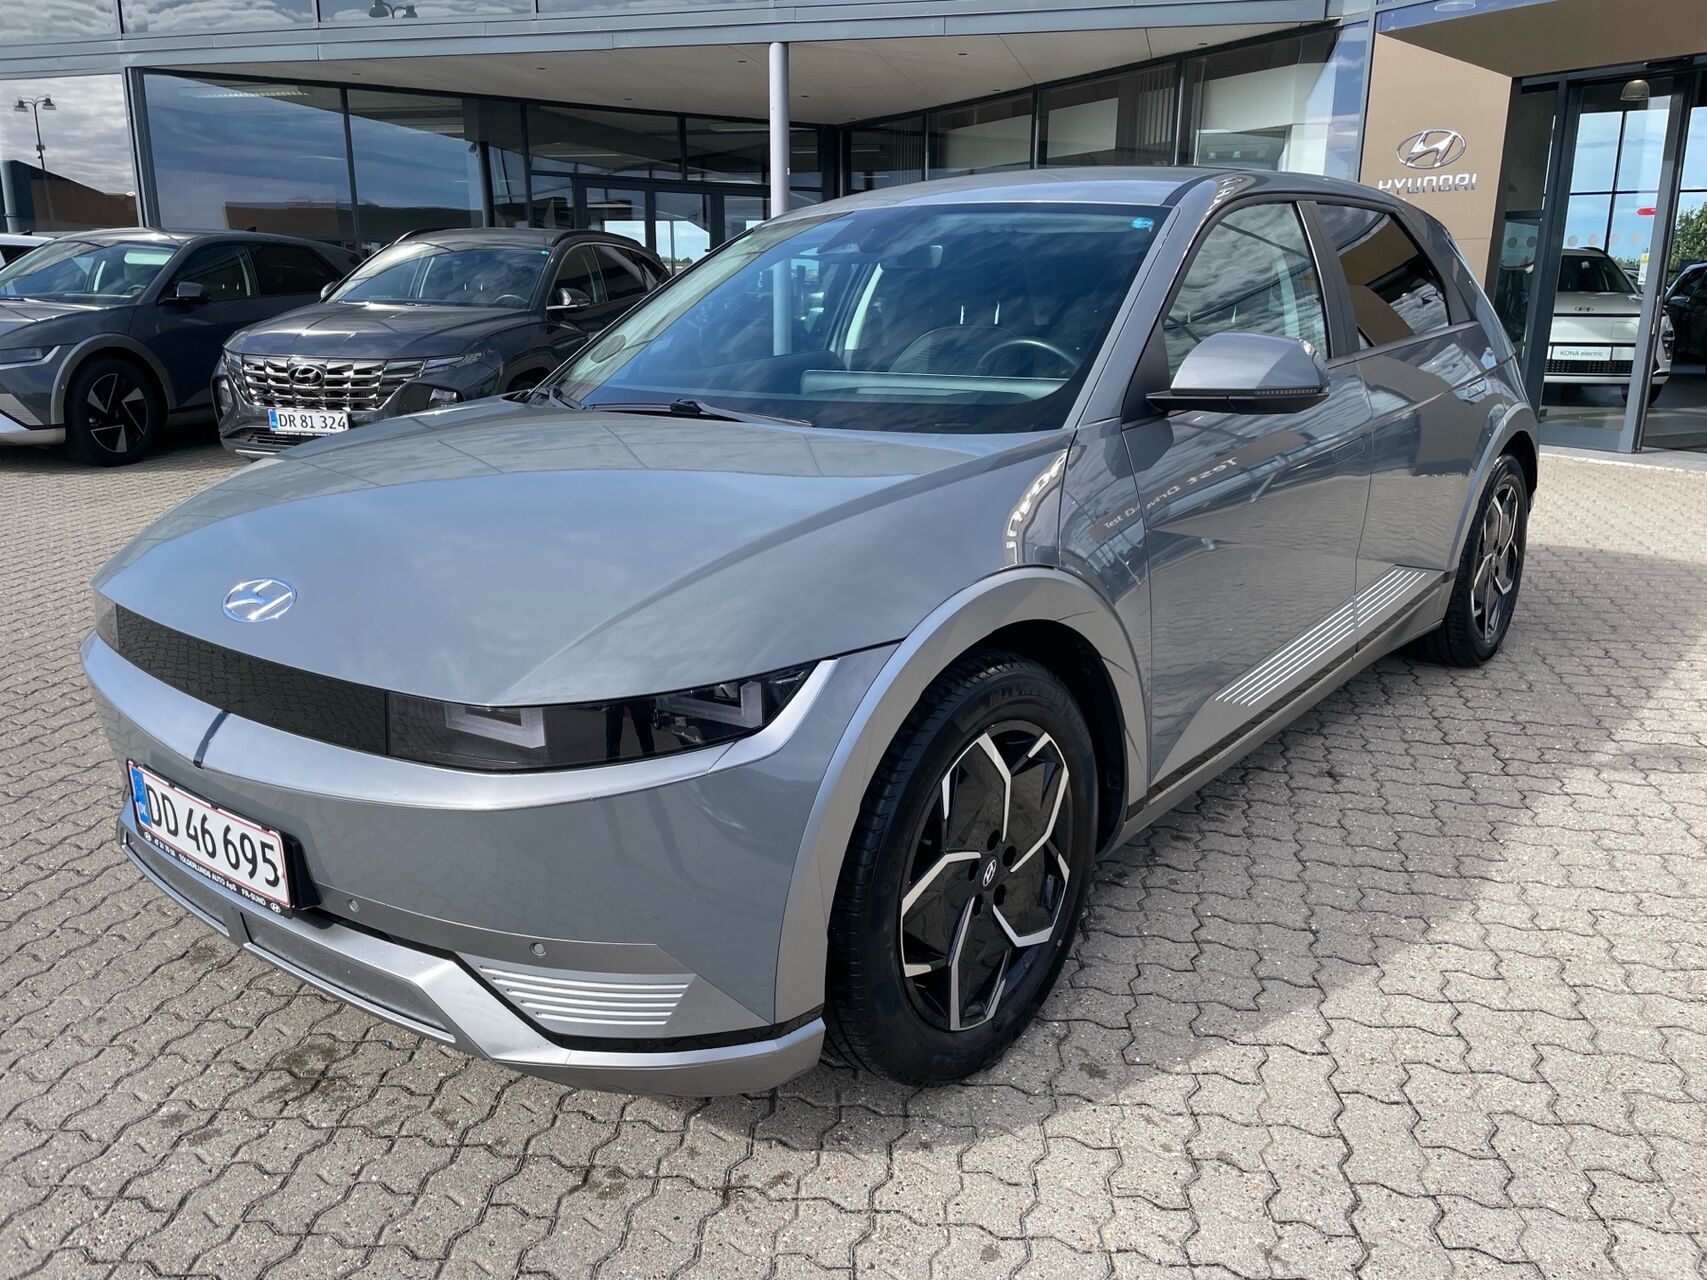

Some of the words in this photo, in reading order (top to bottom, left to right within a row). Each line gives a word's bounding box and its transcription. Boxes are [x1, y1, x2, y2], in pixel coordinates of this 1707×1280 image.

[1377, 172, 1478, 194] HYUNDAI
[279, 414, 297, 428] DR
[300, 414, 315, 429] 81
[320, 415, 346, 430] 324
[144, 783, 179, 838] DD
[185, 807, 217, 859] 46
[222, 824, 280, 888] 695
[211, 872, 226, 885] AUTO
